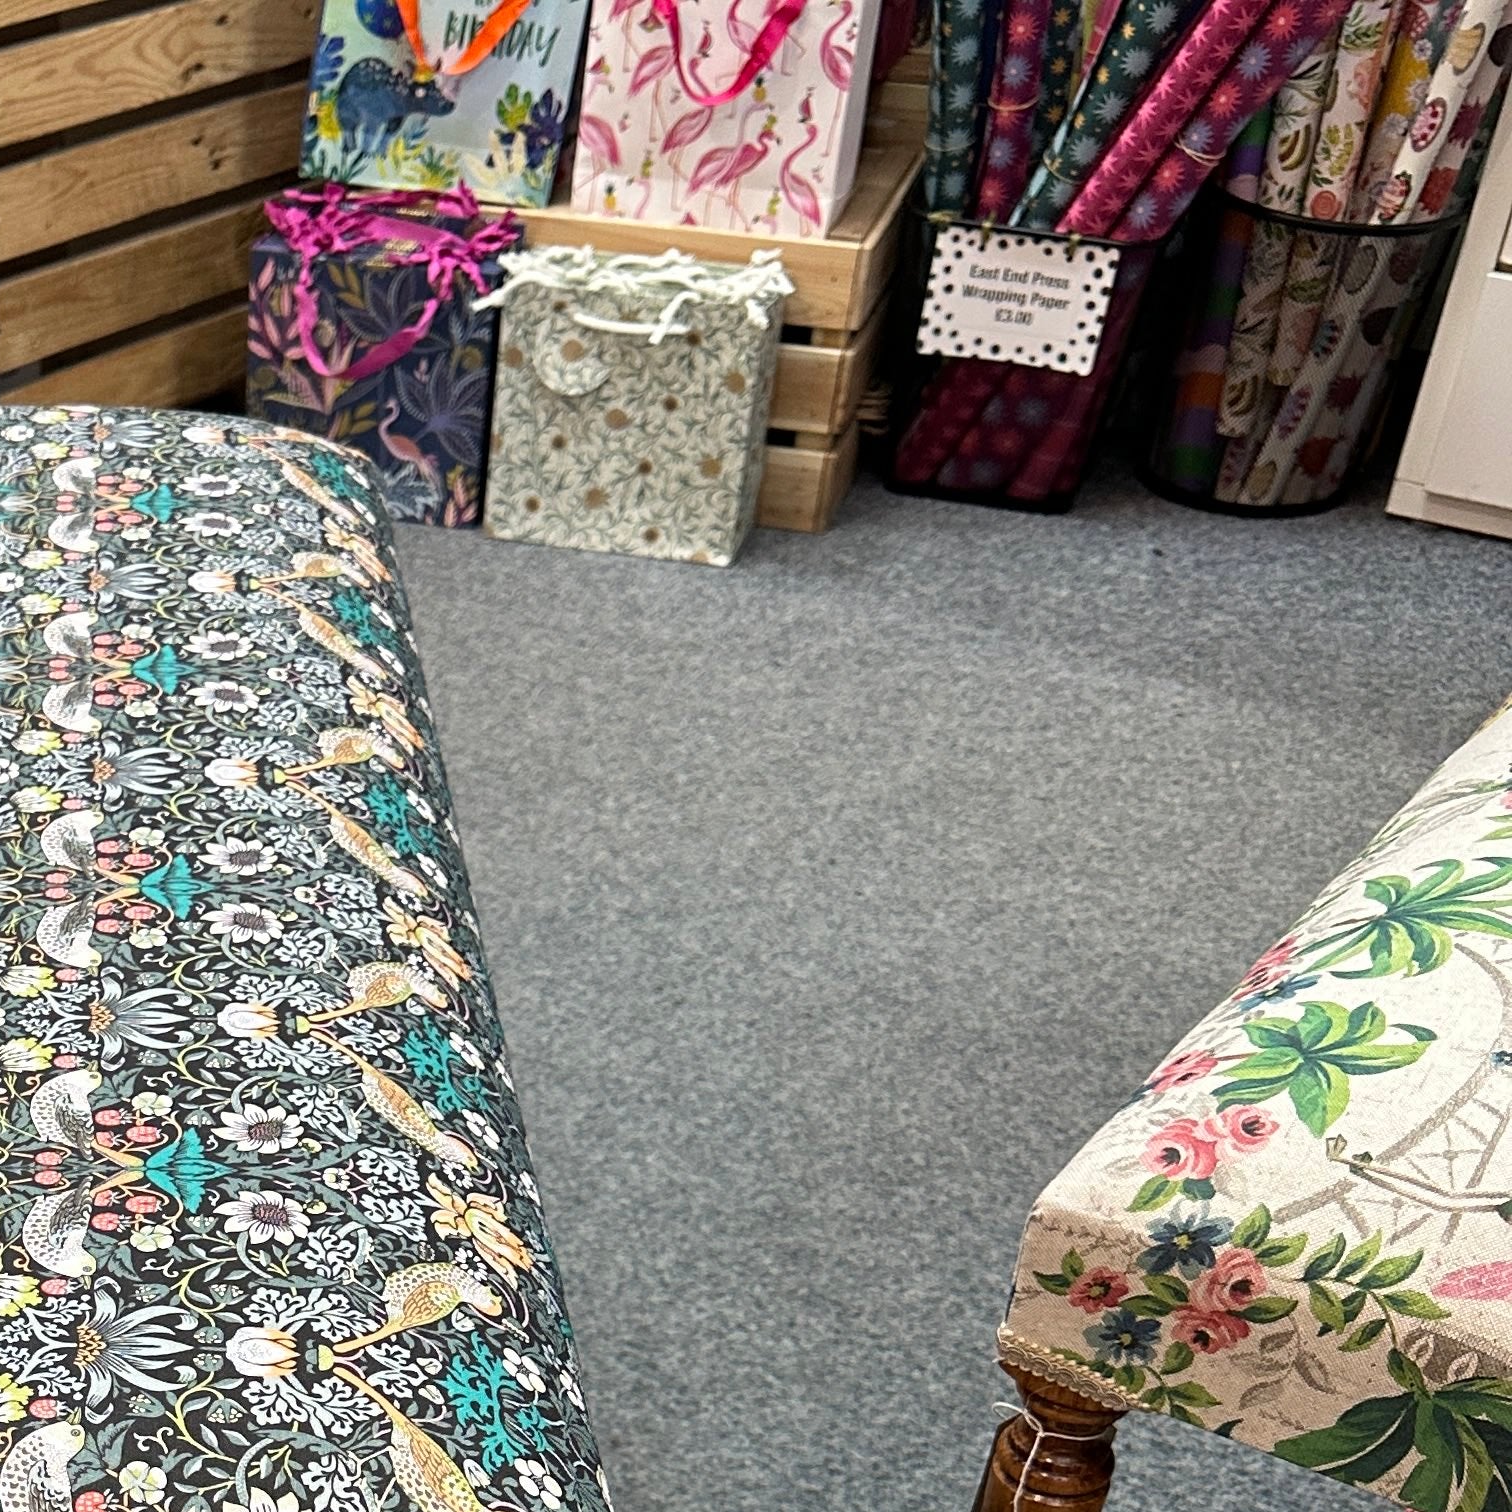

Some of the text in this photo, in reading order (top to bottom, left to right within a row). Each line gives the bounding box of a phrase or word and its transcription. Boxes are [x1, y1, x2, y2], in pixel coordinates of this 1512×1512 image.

[969, 264, 1070, 290] East End Press
[962, 284, 1070, 310] Wrapping Paper
